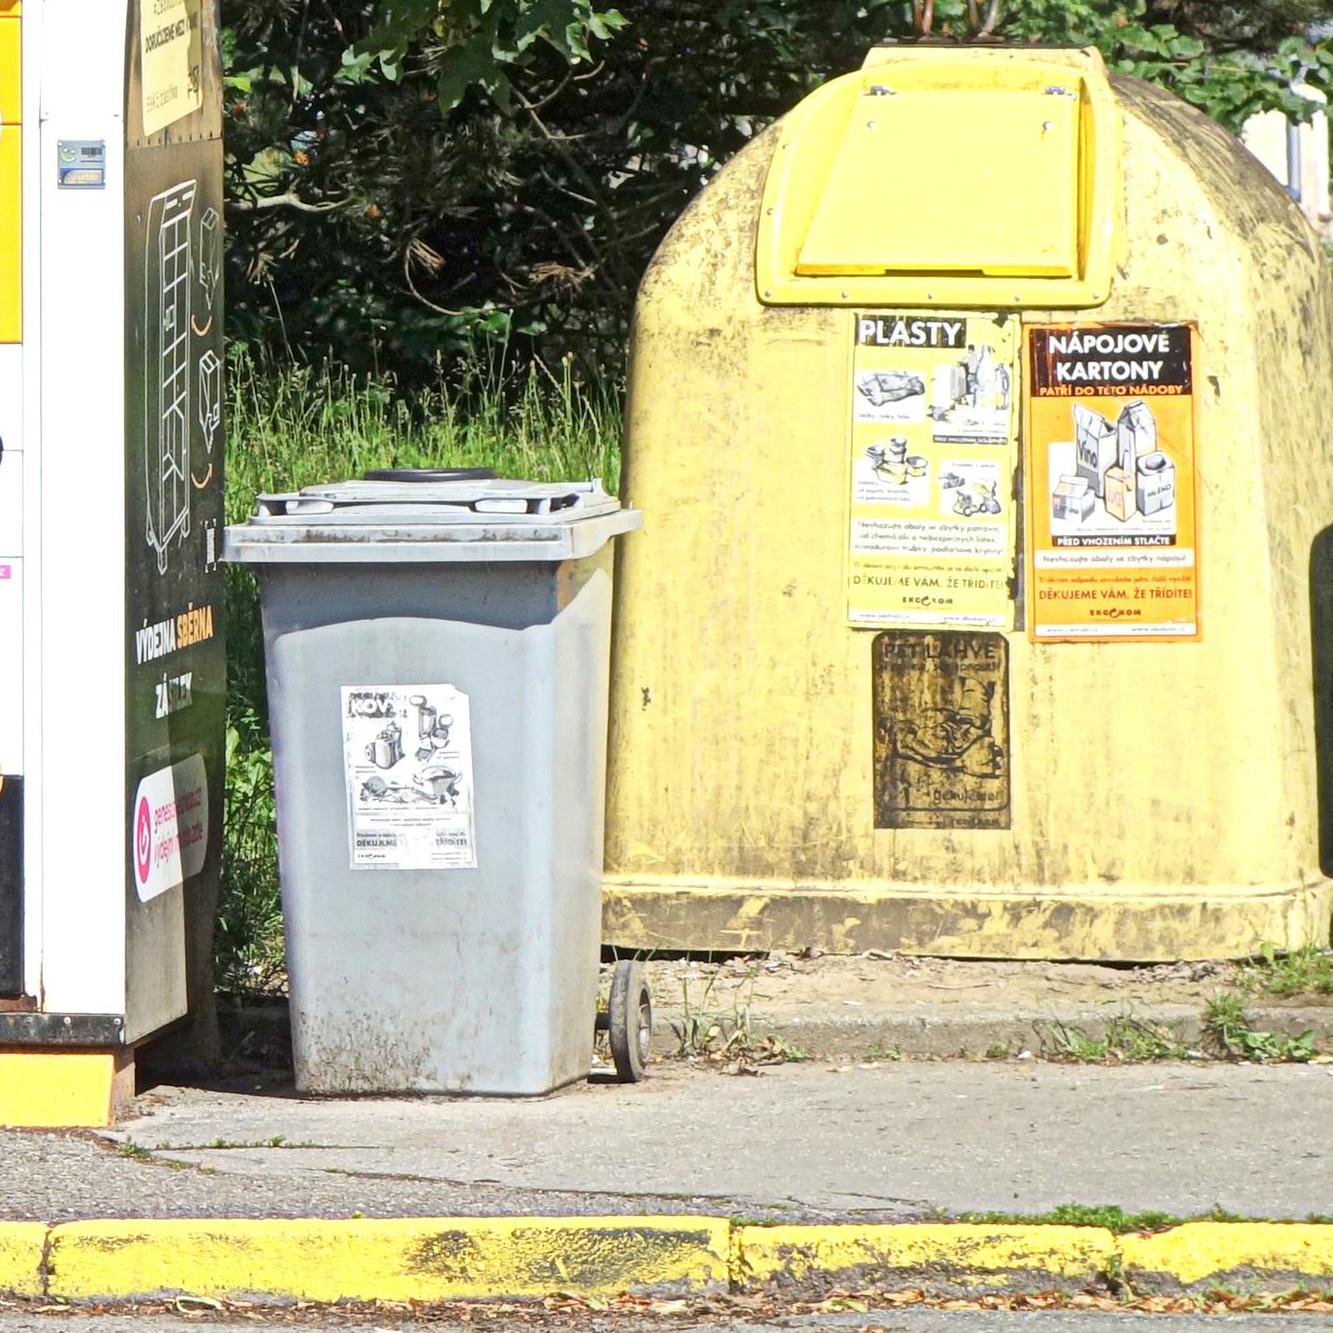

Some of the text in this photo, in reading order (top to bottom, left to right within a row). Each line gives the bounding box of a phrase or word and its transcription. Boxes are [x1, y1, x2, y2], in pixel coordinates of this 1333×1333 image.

[858, 319, 961, 346] PLASTY
[1049, 329, 1170, 353] NÁPOJOVÉ
[1057, 360, 1163, 380] KARTONY
[1039, 384, 1072, 396] PATŘÍ
[1075, 386, 1094, 395] DO
[1129, 384, 1183, 395] NÁDOBY
[1057, 536, 1080, 546] PŘED
[1038, 587, 1097, 600] DĚKUJEME
[1133, 586, 1146, 599] ŽE
[136, 602, 213, 665] VÝDEJNA SBĚRNA
